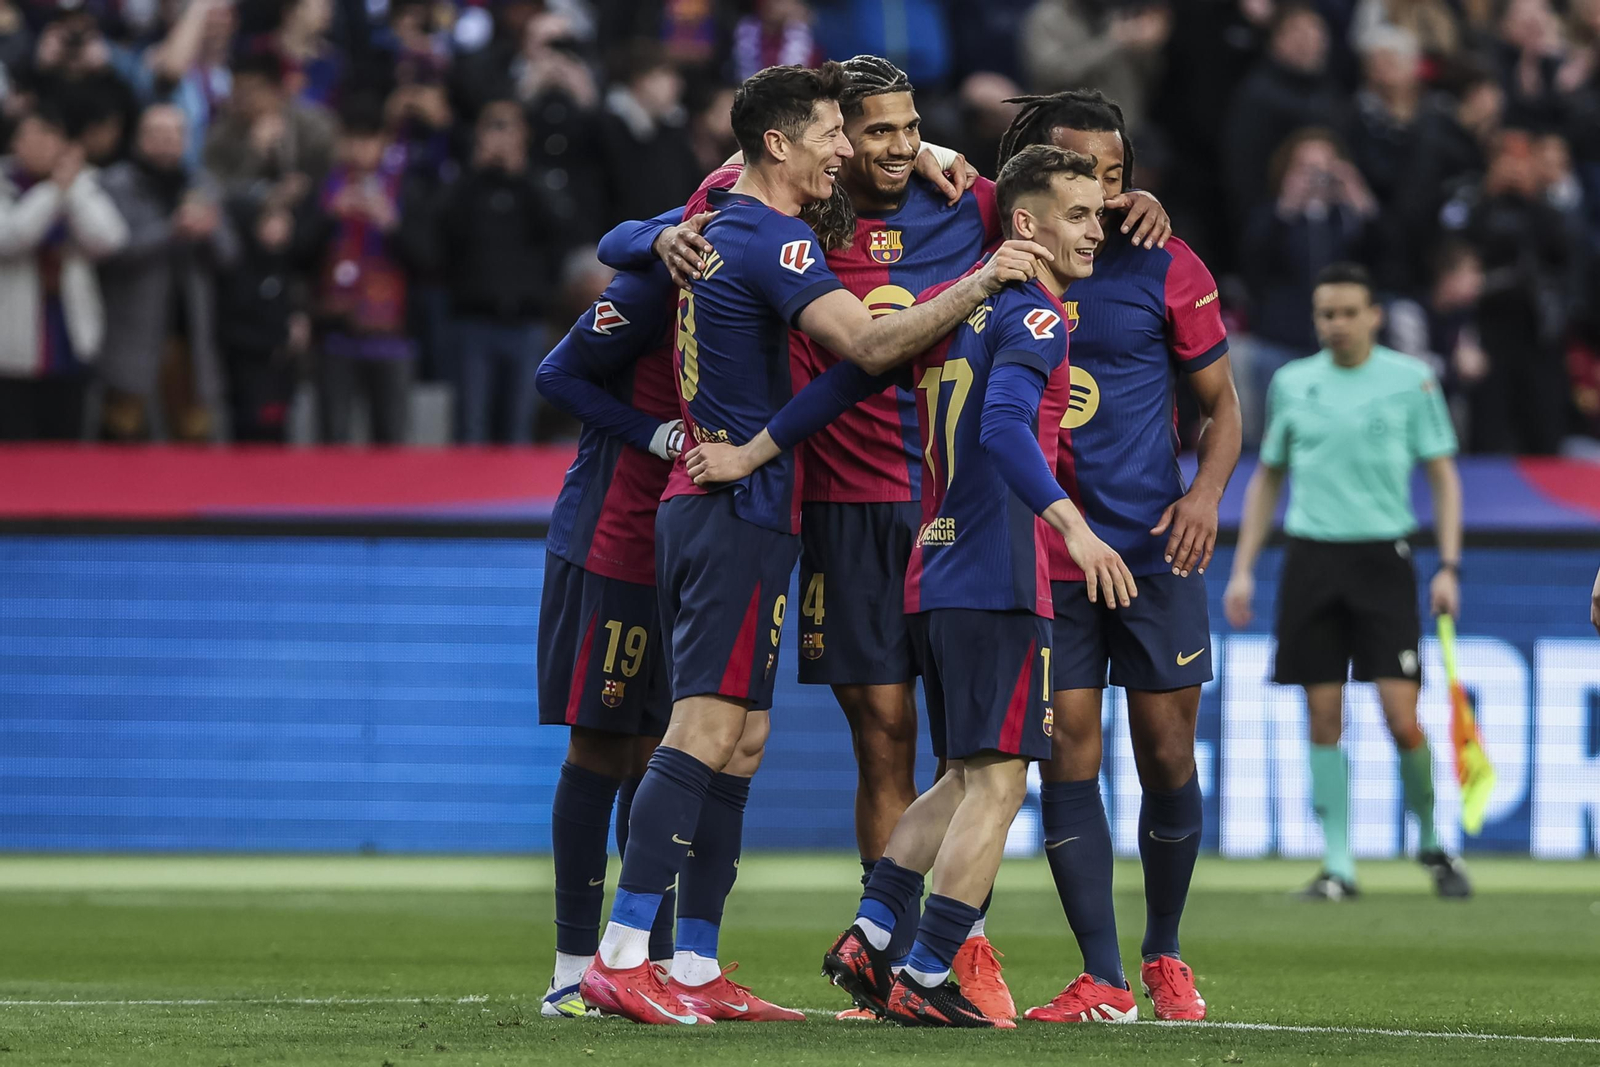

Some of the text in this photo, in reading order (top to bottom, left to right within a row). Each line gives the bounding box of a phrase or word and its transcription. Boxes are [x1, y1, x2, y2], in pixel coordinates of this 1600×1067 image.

[917, 357, 974, 497] 17
[770, 594, 787, 647] 9
[802, 573, 825, 625] 4
[603, 619, 648, 678] 19
